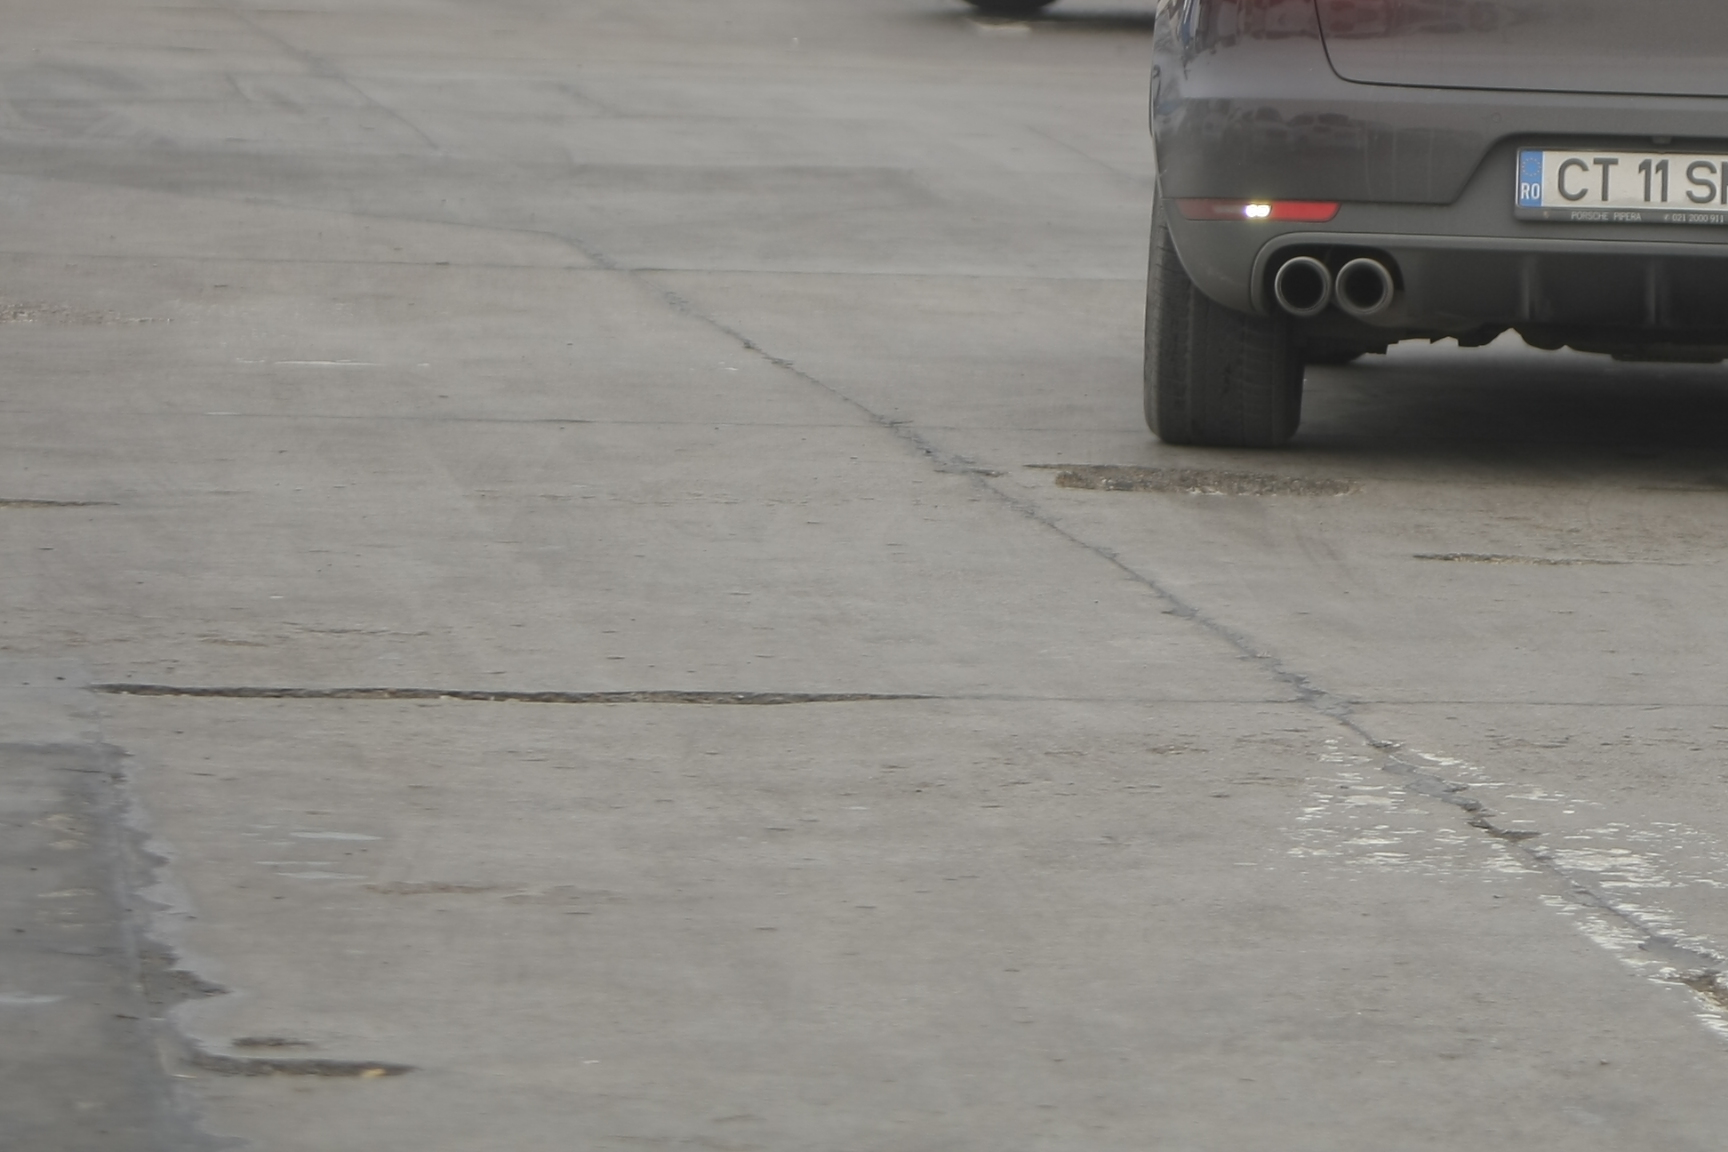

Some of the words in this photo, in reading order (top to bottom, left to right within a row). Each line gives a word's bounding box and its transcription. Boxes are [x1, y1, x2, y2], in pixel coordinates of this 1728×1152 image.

[1557, 156, 1619, 202] CT
[1638, 158, 1669, 203] 11
[1520, 182, 1541, 200] RO
[1571, 210, 1609, 221] PORSCHE
[1613, 211, 1642, 222] PIPERA
[1671, 213, 1687, 223] 021
[1688, 213, 1709, 223] 2000
[1709, 214, 1725, 224] 911
